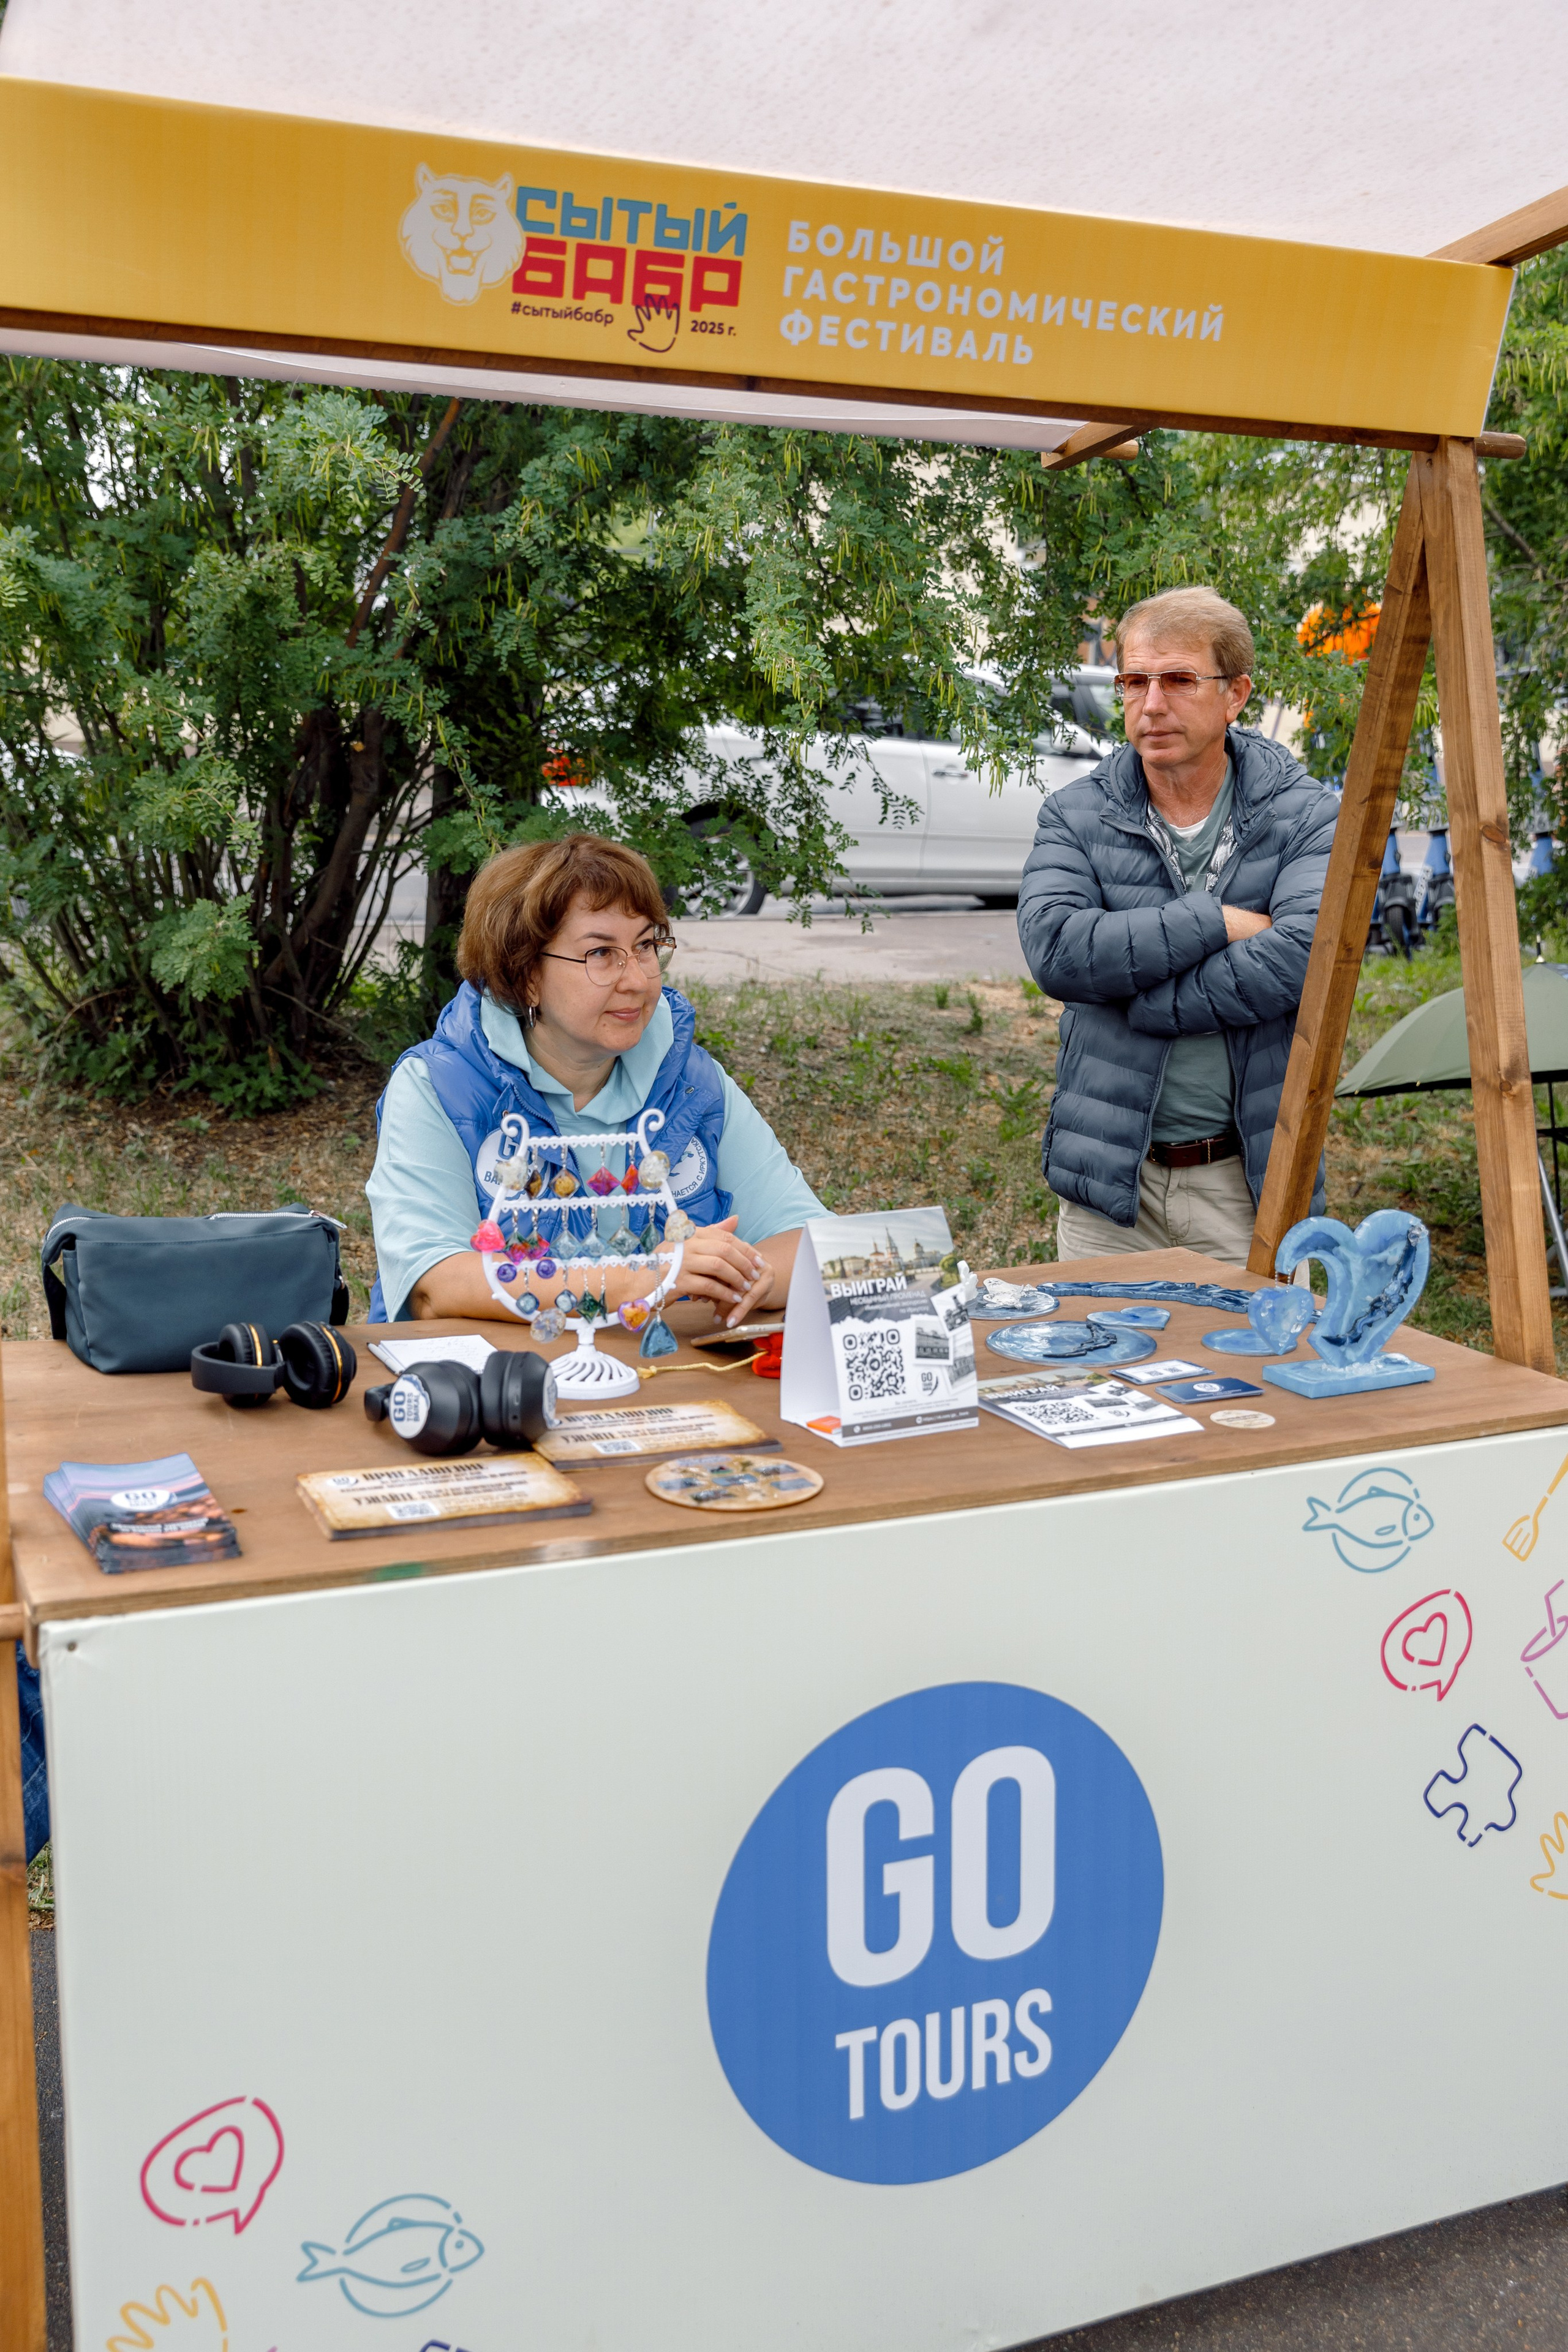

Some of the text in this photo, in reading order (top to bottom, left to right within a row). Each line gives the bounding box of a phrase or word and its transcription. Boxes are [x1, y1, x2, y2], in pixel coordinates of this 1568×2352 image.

[516, 186, 748, 257] СЫТЫЙ
[787, 221, 1005, 276] БОЛЬШОЙ
[512, 236, 742, 313] БАБР
[511, 301, 614, 327] #сытыйбабр
[690, 319, 737, 337] 2025 г.
[782, 266, 1224, 342] ГАСТРОНОМИЧЕСКИЙ
[779, 309, 1034, 366] ФЕСТИВАЛЬ
[671, 1181, 698, 1197] НАЕТСЯ
[691, 1137, 706, 1175] ИРКУТСКА
[830, 1272, 908, 1298] ВЫИГРАЙ
[921, 1372, 933, 1382] GO
[394, 1391, 405, 1422] GO
[826, 1745, 1056, 1987] GO
[835, 1988, 1052, 2120] TOURS
